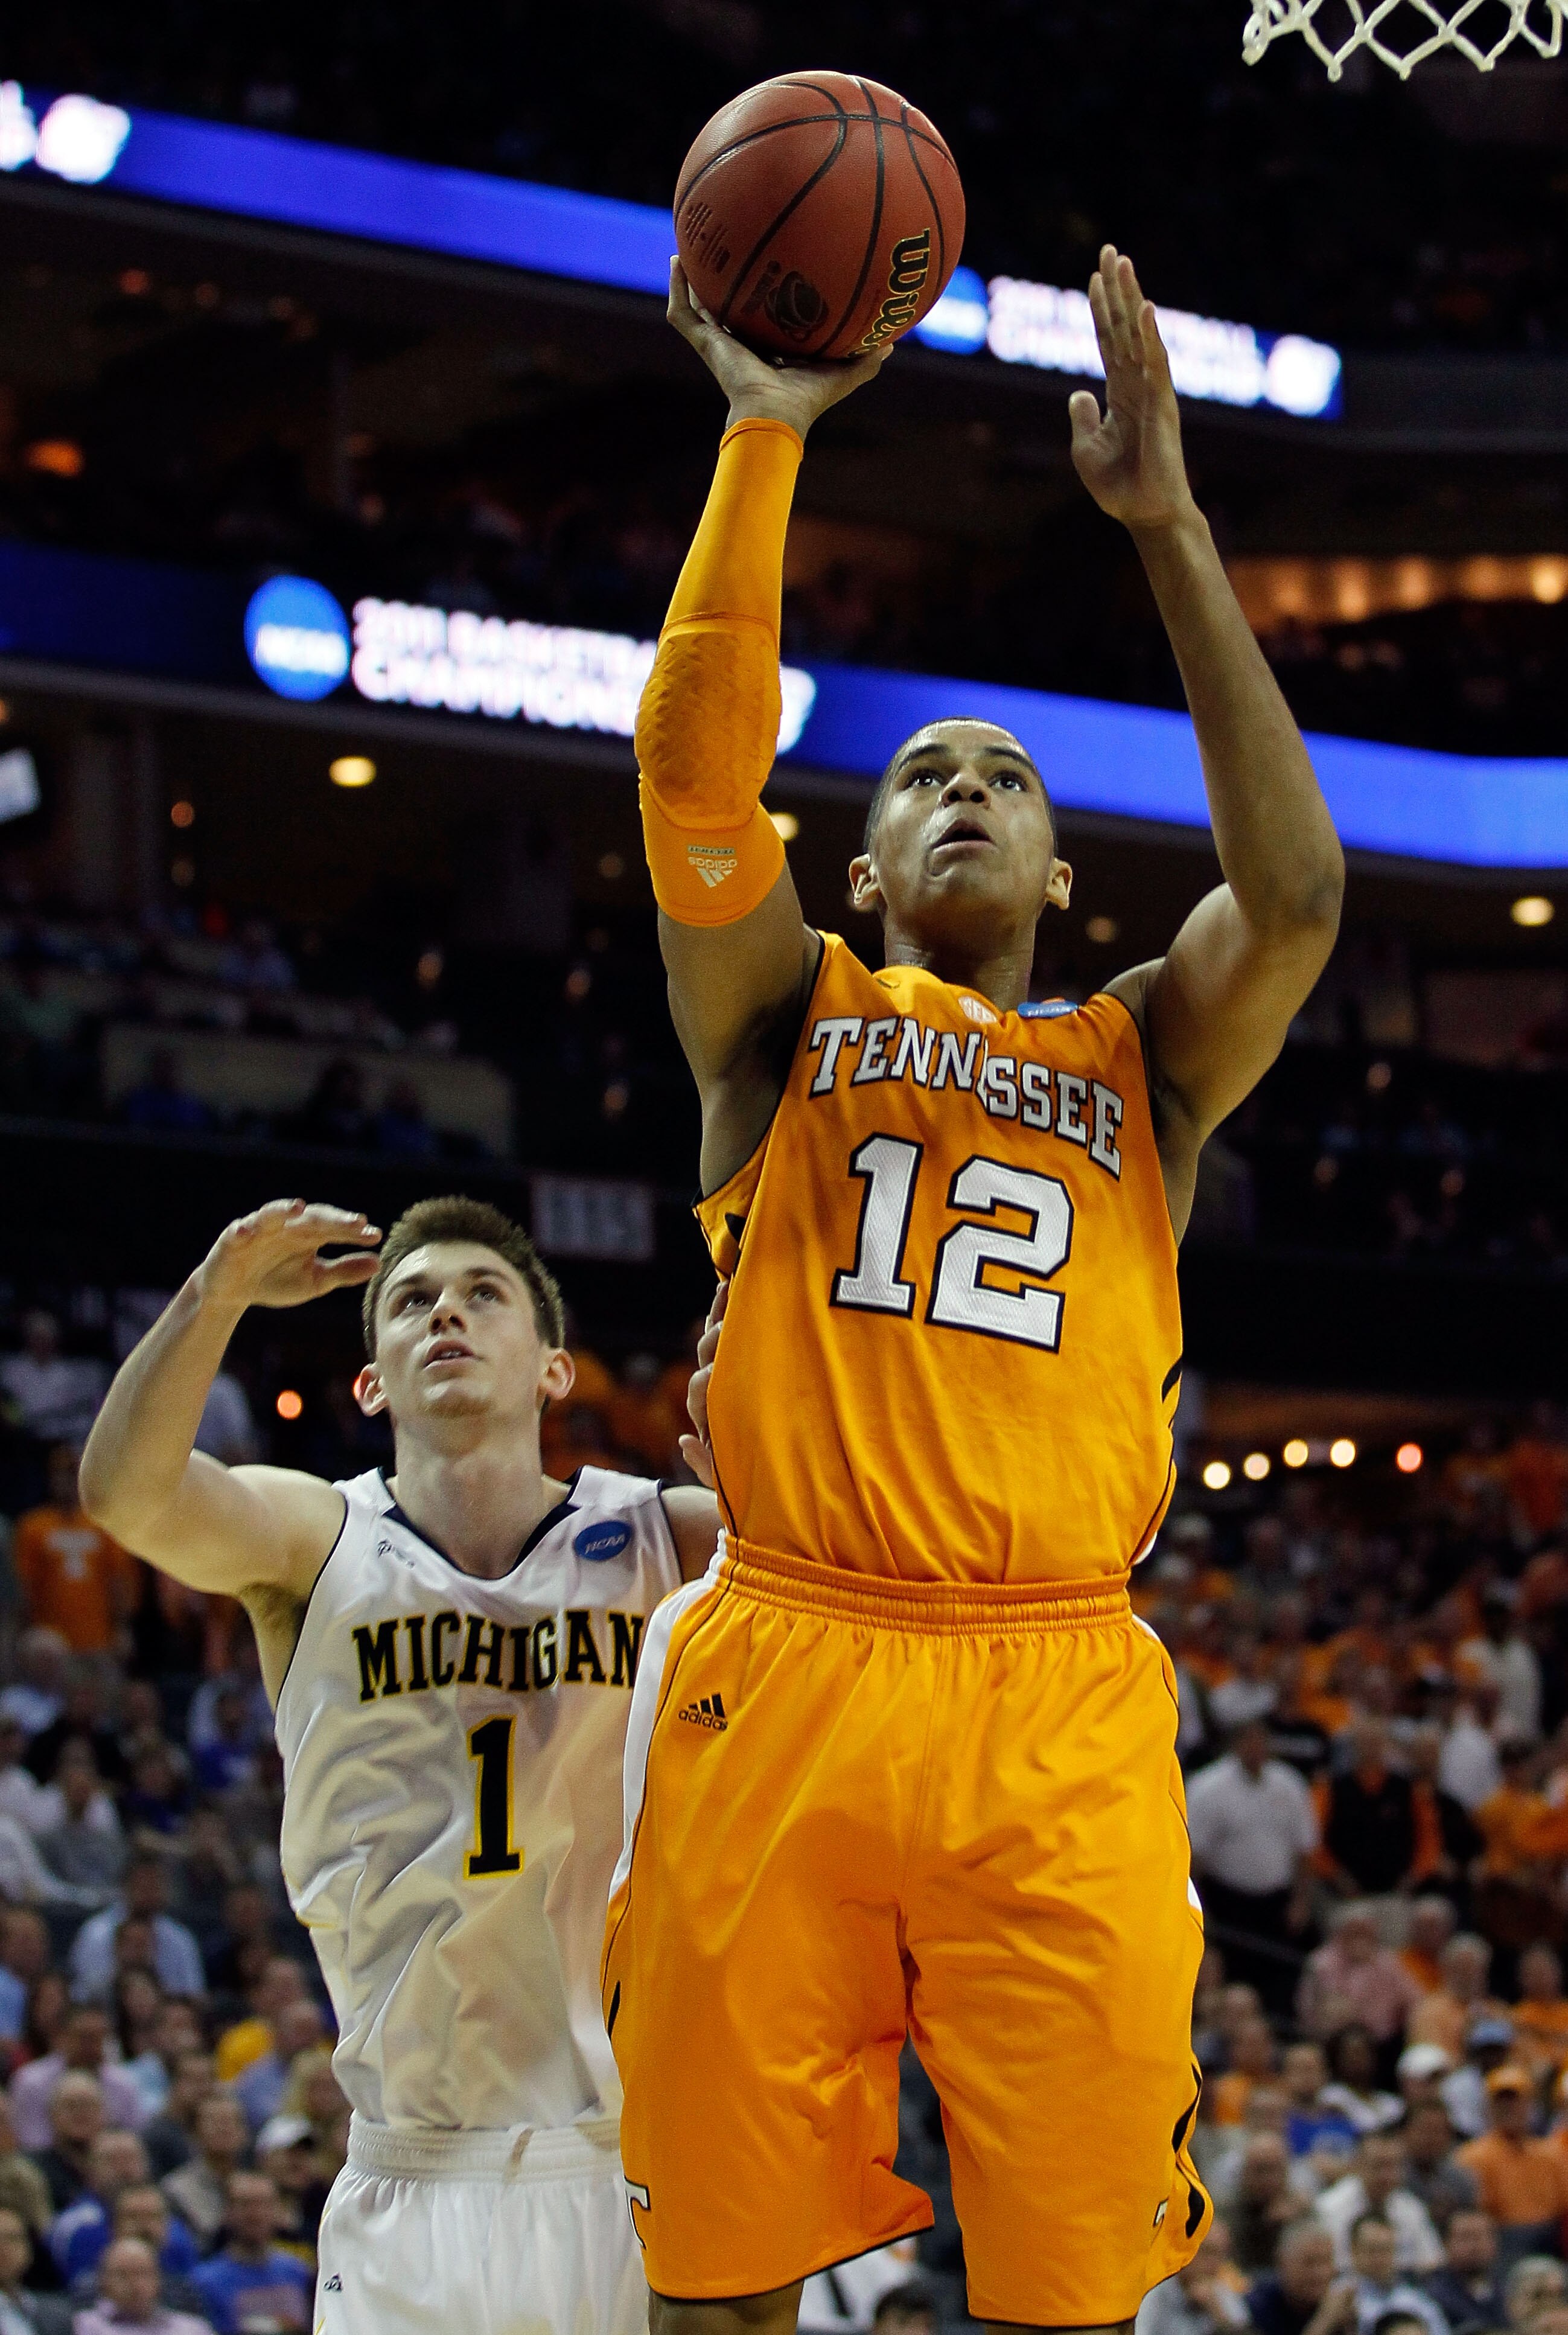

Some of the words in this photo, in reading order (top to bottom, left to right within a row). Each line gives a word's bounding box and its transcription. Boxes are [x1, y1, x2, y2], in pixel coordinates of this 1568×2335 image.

[687, 856, 738, 870] adidas
[809, 1017, 1123, 1181] TENNSSEE
[830, 1132, 1074, 1353] 12
[352, 1611, 644, 1702] MICHIGAN
[678, 1709, 728, 1731] adidas
[464, 1715, 524, 1879] 1
